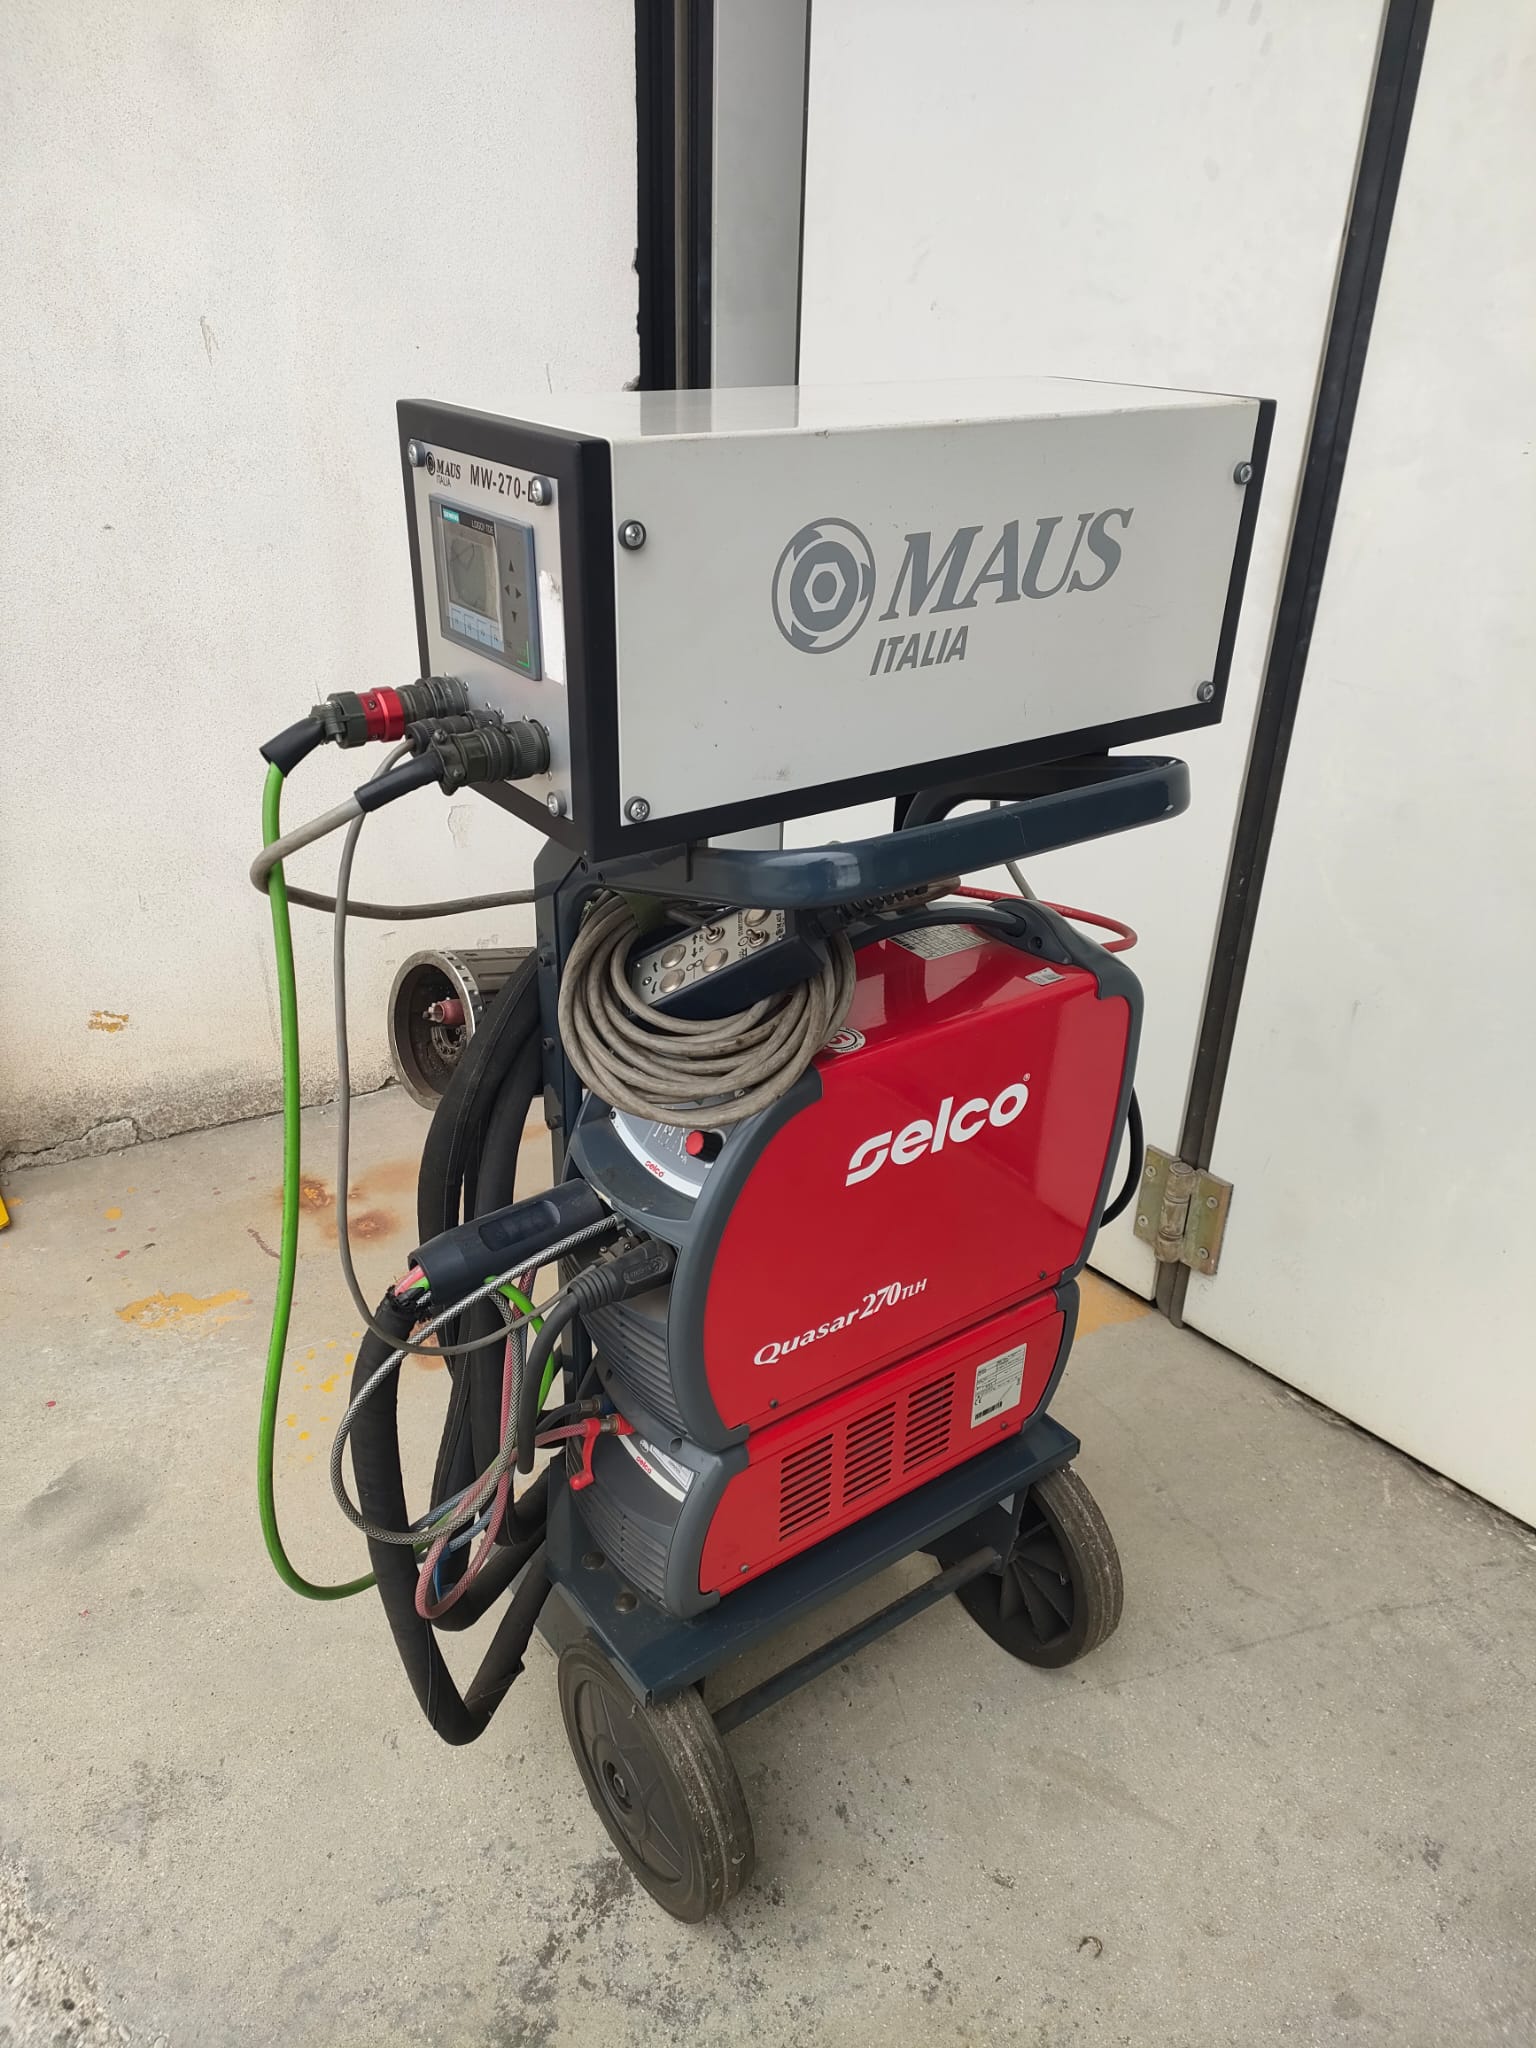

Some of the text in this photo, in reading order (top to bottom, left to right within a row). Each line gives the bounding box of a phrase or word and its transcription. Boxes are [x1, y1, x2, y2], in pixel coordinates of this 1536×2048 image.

[436, 459, 461, 480] MAUS
[878, 508, 1134, 622] MAUS
[869, 625, 969, 676] ITALIA
[753, 1308, 860, 1365] Quasar
